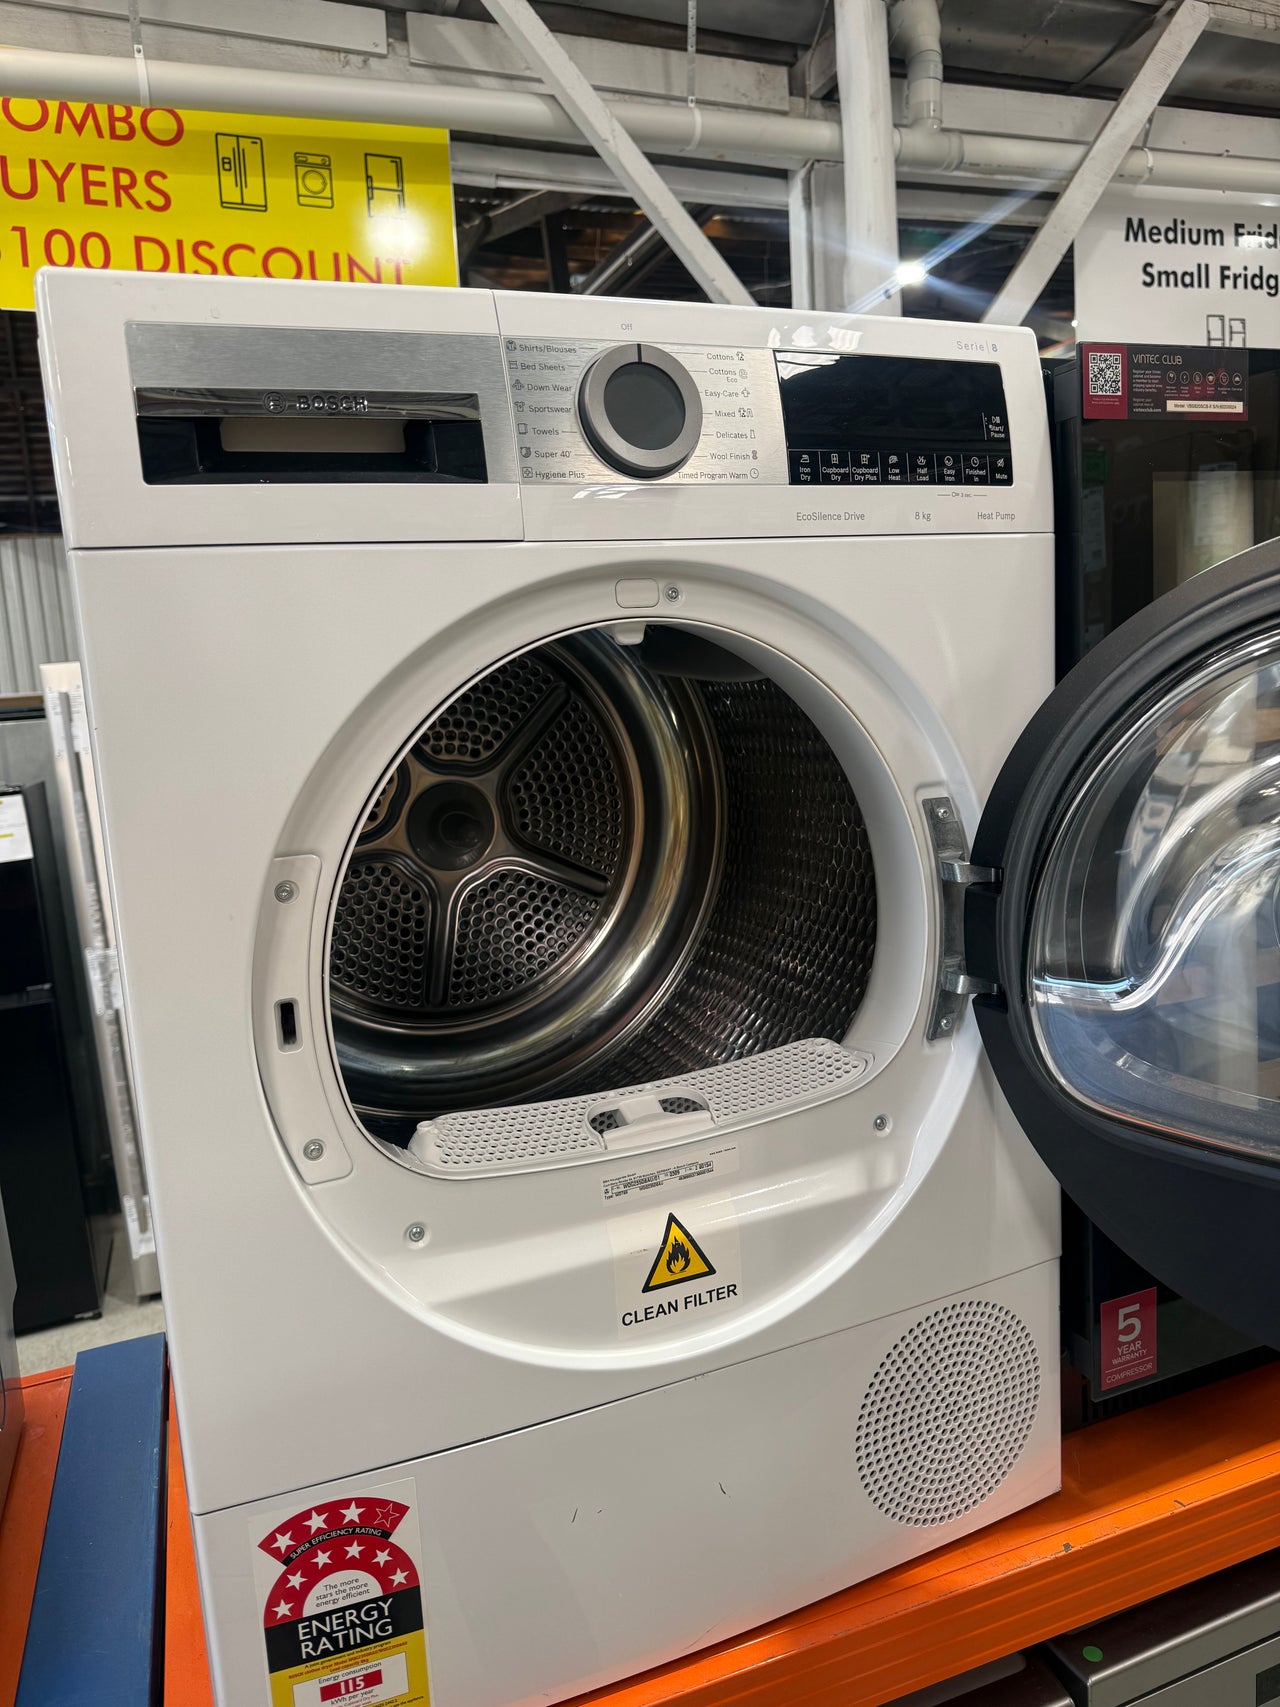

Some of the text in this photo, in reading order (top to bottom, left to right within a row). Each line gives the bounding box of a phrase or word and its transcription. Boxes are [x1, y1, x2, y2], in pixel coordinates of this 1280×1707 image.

[2, 97, 185, 146] OMBO
[0, 155, 172, 212] UYERS
[1124, 217, 1224, 246] Medium
[0, 226, 411, 285] 100 DISCOUNT
[1142, 262, 1280, 297] Small Fridg
[620, 323, 633, 331] Off
[518, 344, 577, 354] Shirts/Blouses
[956, 340, 998, 352] Serie 8
[706, 353, 735, 361] Cottons
[1133, 354, 1183, 365] VINTEC CLUB
[520, 362, 566, 372] Bed Sheets
[708, 367, 737, 376] Cottons
[552, 384, 572, 392] Wear
[704, 389, 739, 398] Easy-Care
[297, 396, 368, 411] BOSCH
[528, 405, 572, 414] Sportswear
[715, 410, 736, 418] Mixed
[532, 427, 559, 436] Towels
[716, 430, 748, 439] Delicates
[534, 451, 557, 459] Super
[710, 452, 750, 461] Wool Finish
[535, 470, 585, 480] Hygiene Plus
[678, 471, 748, 481] Timed Program Warm
[800, 474, 811, 482] Dry
[831, 474, 841, 482] Dry
[854, 474, 864, 482] Dry
[796, 512, 865, 521] EcoSilence Drive
[915, 512, 931, 523] 8 kg
[977, 512, 1016, 523] Heat Pump
[621, 1284, 738, 1327] CLEAN FILTER
[1118, 1303, 1142, 1342] 5
[1117, 1340, 1142, 1355] YEAR
[1112, 1349, 1147, 1365] WARRANTY
[1106, 1362, 1153, 1383] COMPRESSOR
[289, 1527, 382, 1560] SUPER EFFICIENCY RATING
[324, 1578, 360, 1592] The more
[316, 1582, 368, 1601] stars the more
[316, 1588, 370, 1609] energy efficient
[298, 1598, 393, 1640] ENERGY
[301, 1618, 393, 1660] RATING
[318, 1662, 382, 1684] Energy consumption
[340, 1676, 365, 1694] 115
[330, 1688, 375, 1705] kWh per year
